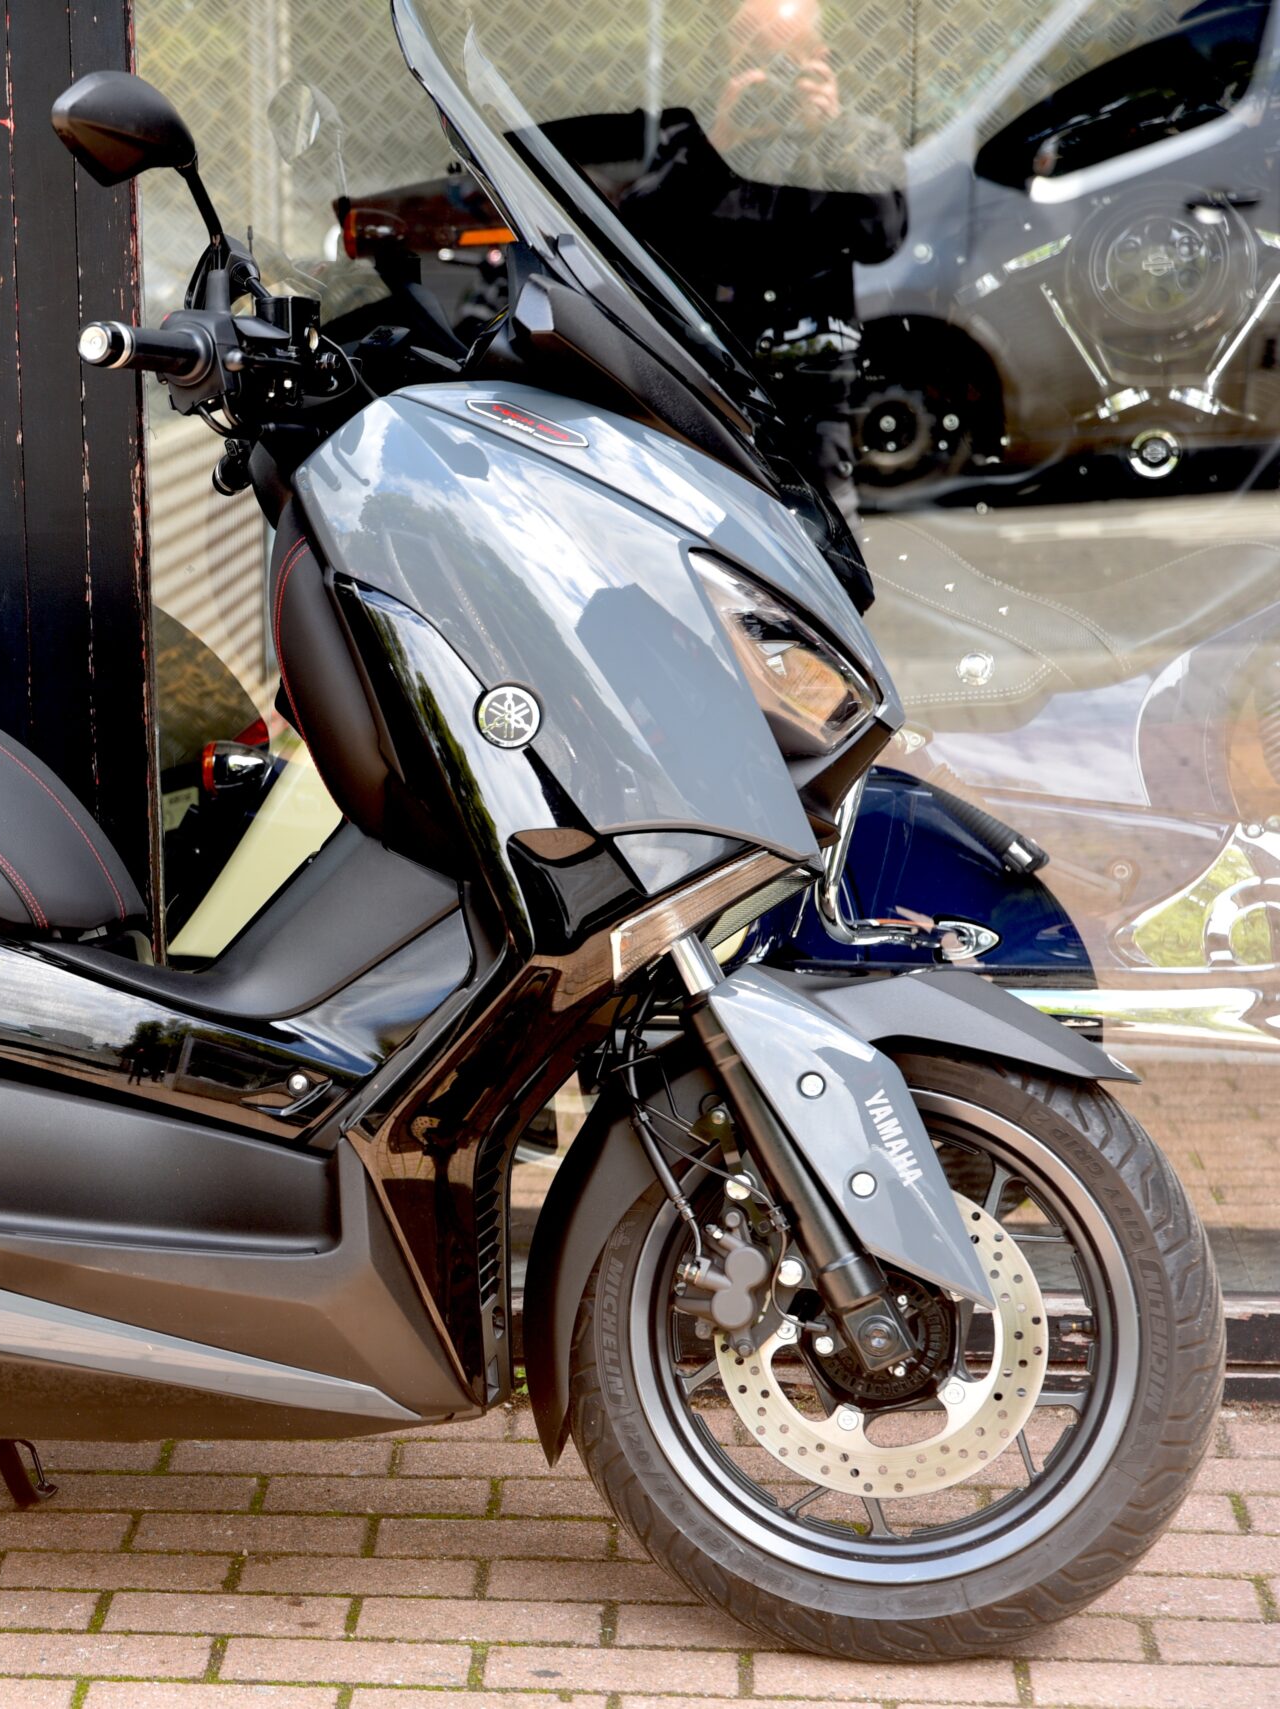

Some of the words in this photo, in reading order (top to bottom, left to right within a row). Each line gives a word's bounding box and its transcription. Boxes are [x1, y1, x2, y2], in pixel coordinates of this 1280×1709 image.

[864, 1088, 923, 1187] YAMAHA
[1027, 1108, 1051, 1126] 2
[1048, 1127, 1106, 1180] GRIP
[1100, 1184, 1146, 1245] CITY
[602, 1256, 625, 1396] MICHELIN
[1143, 1269, 1169, 1414] MICHELIN
